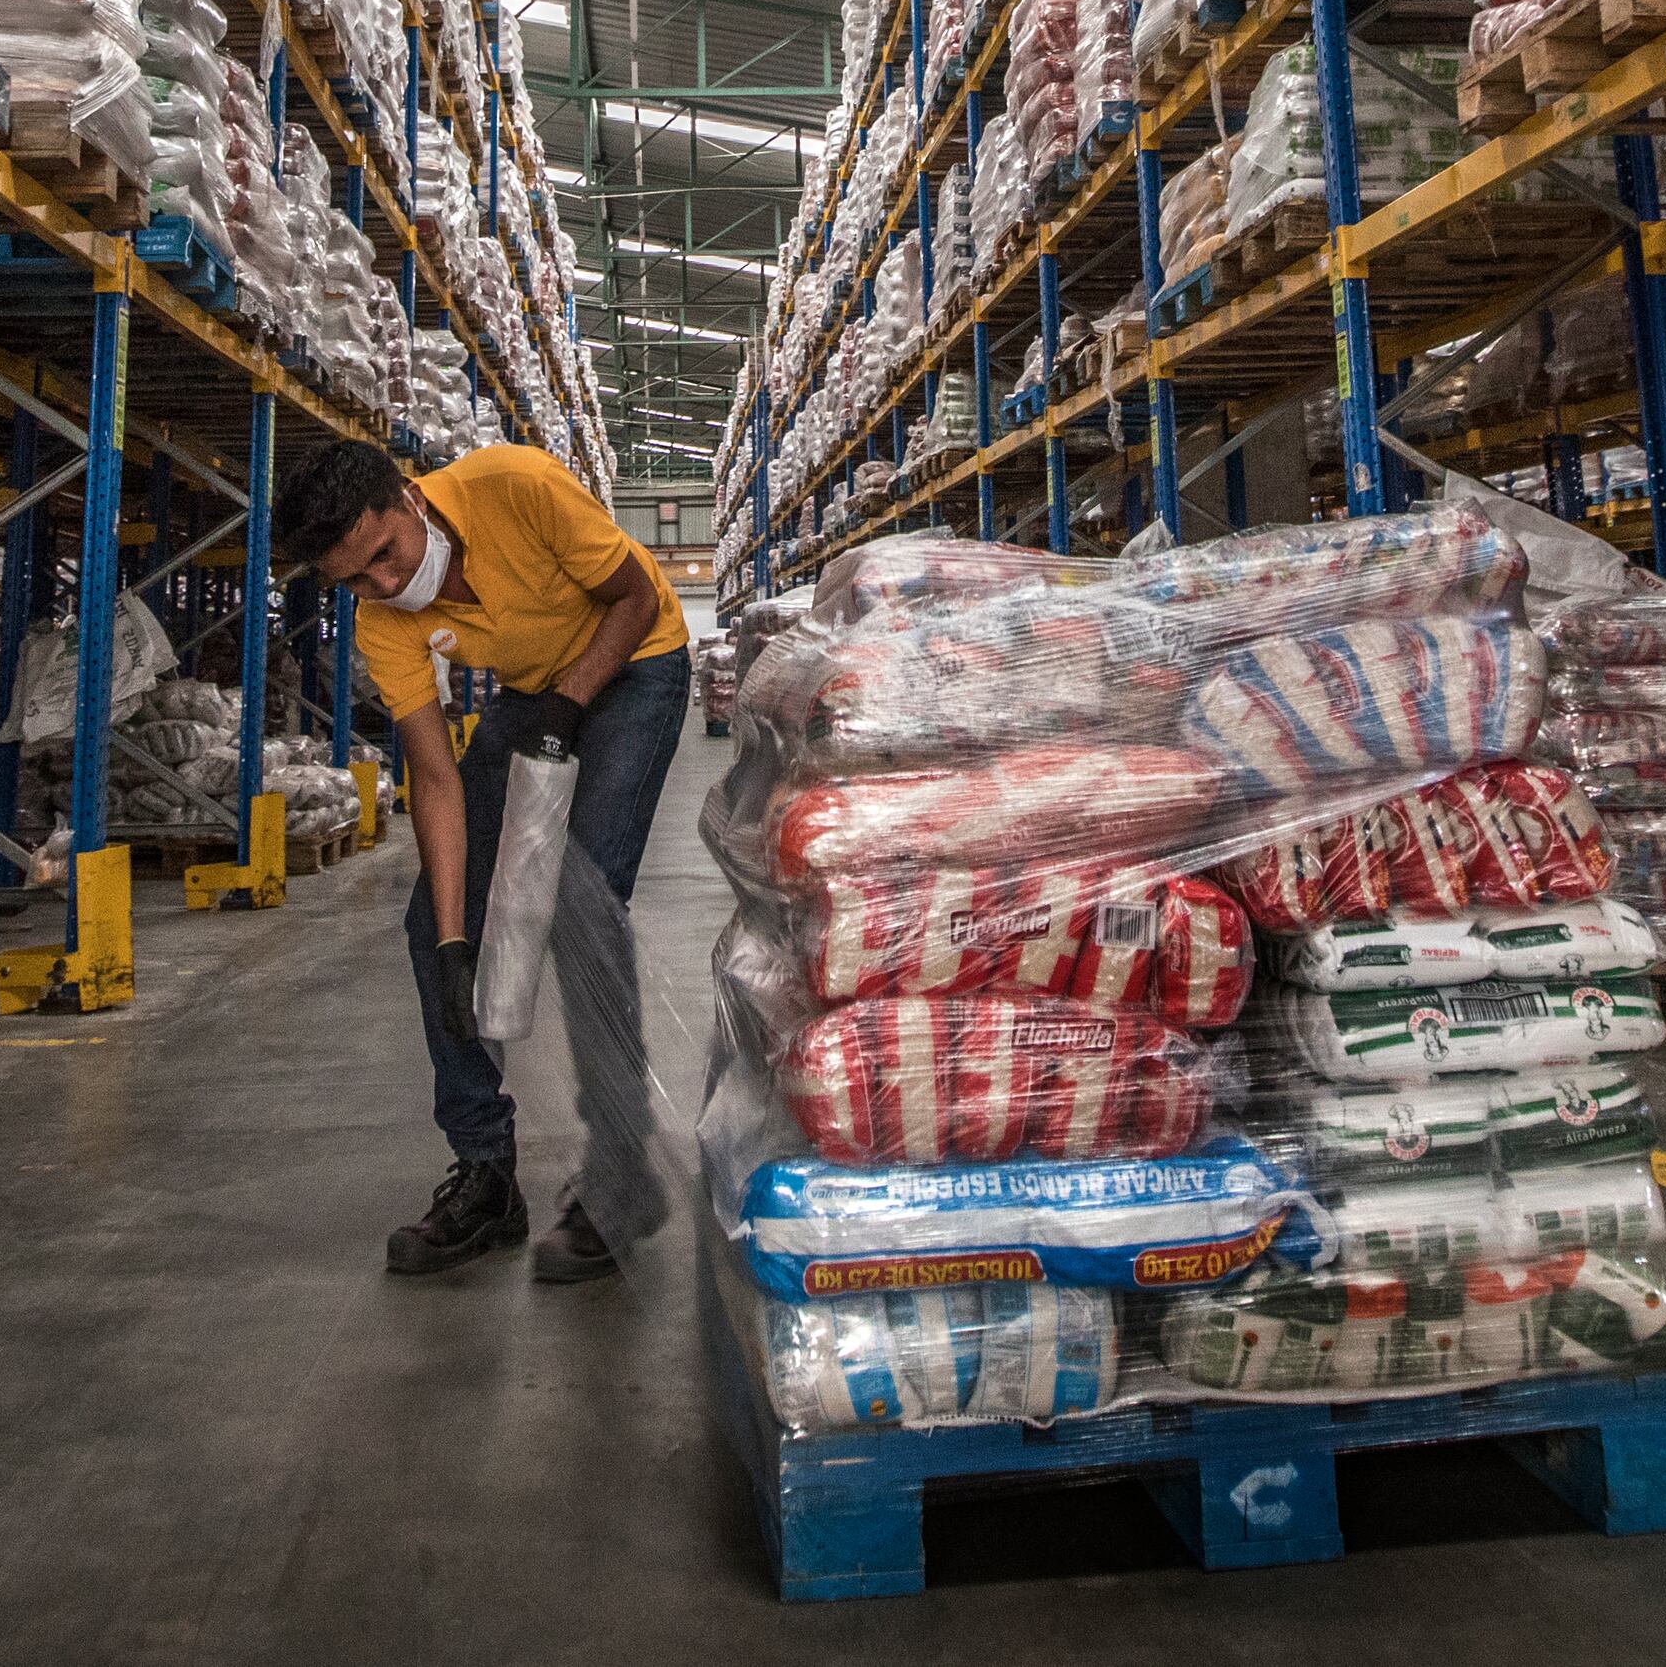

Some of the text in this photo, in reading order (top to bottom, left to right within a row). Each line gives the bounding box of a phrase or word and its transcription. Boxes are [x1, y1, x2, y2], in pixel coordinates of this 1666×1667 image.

[1009, 1172, 1106, 1200] BLANCO
[1113, 1166, 1206, 1197] AZÚCAR
[814, 1258, 1032, 1289] 10 BOLSAS DE 2.5 kg
[1143, 1255, 1171, 1281] kg
[1177, 1255, 1203, 1280] 25
